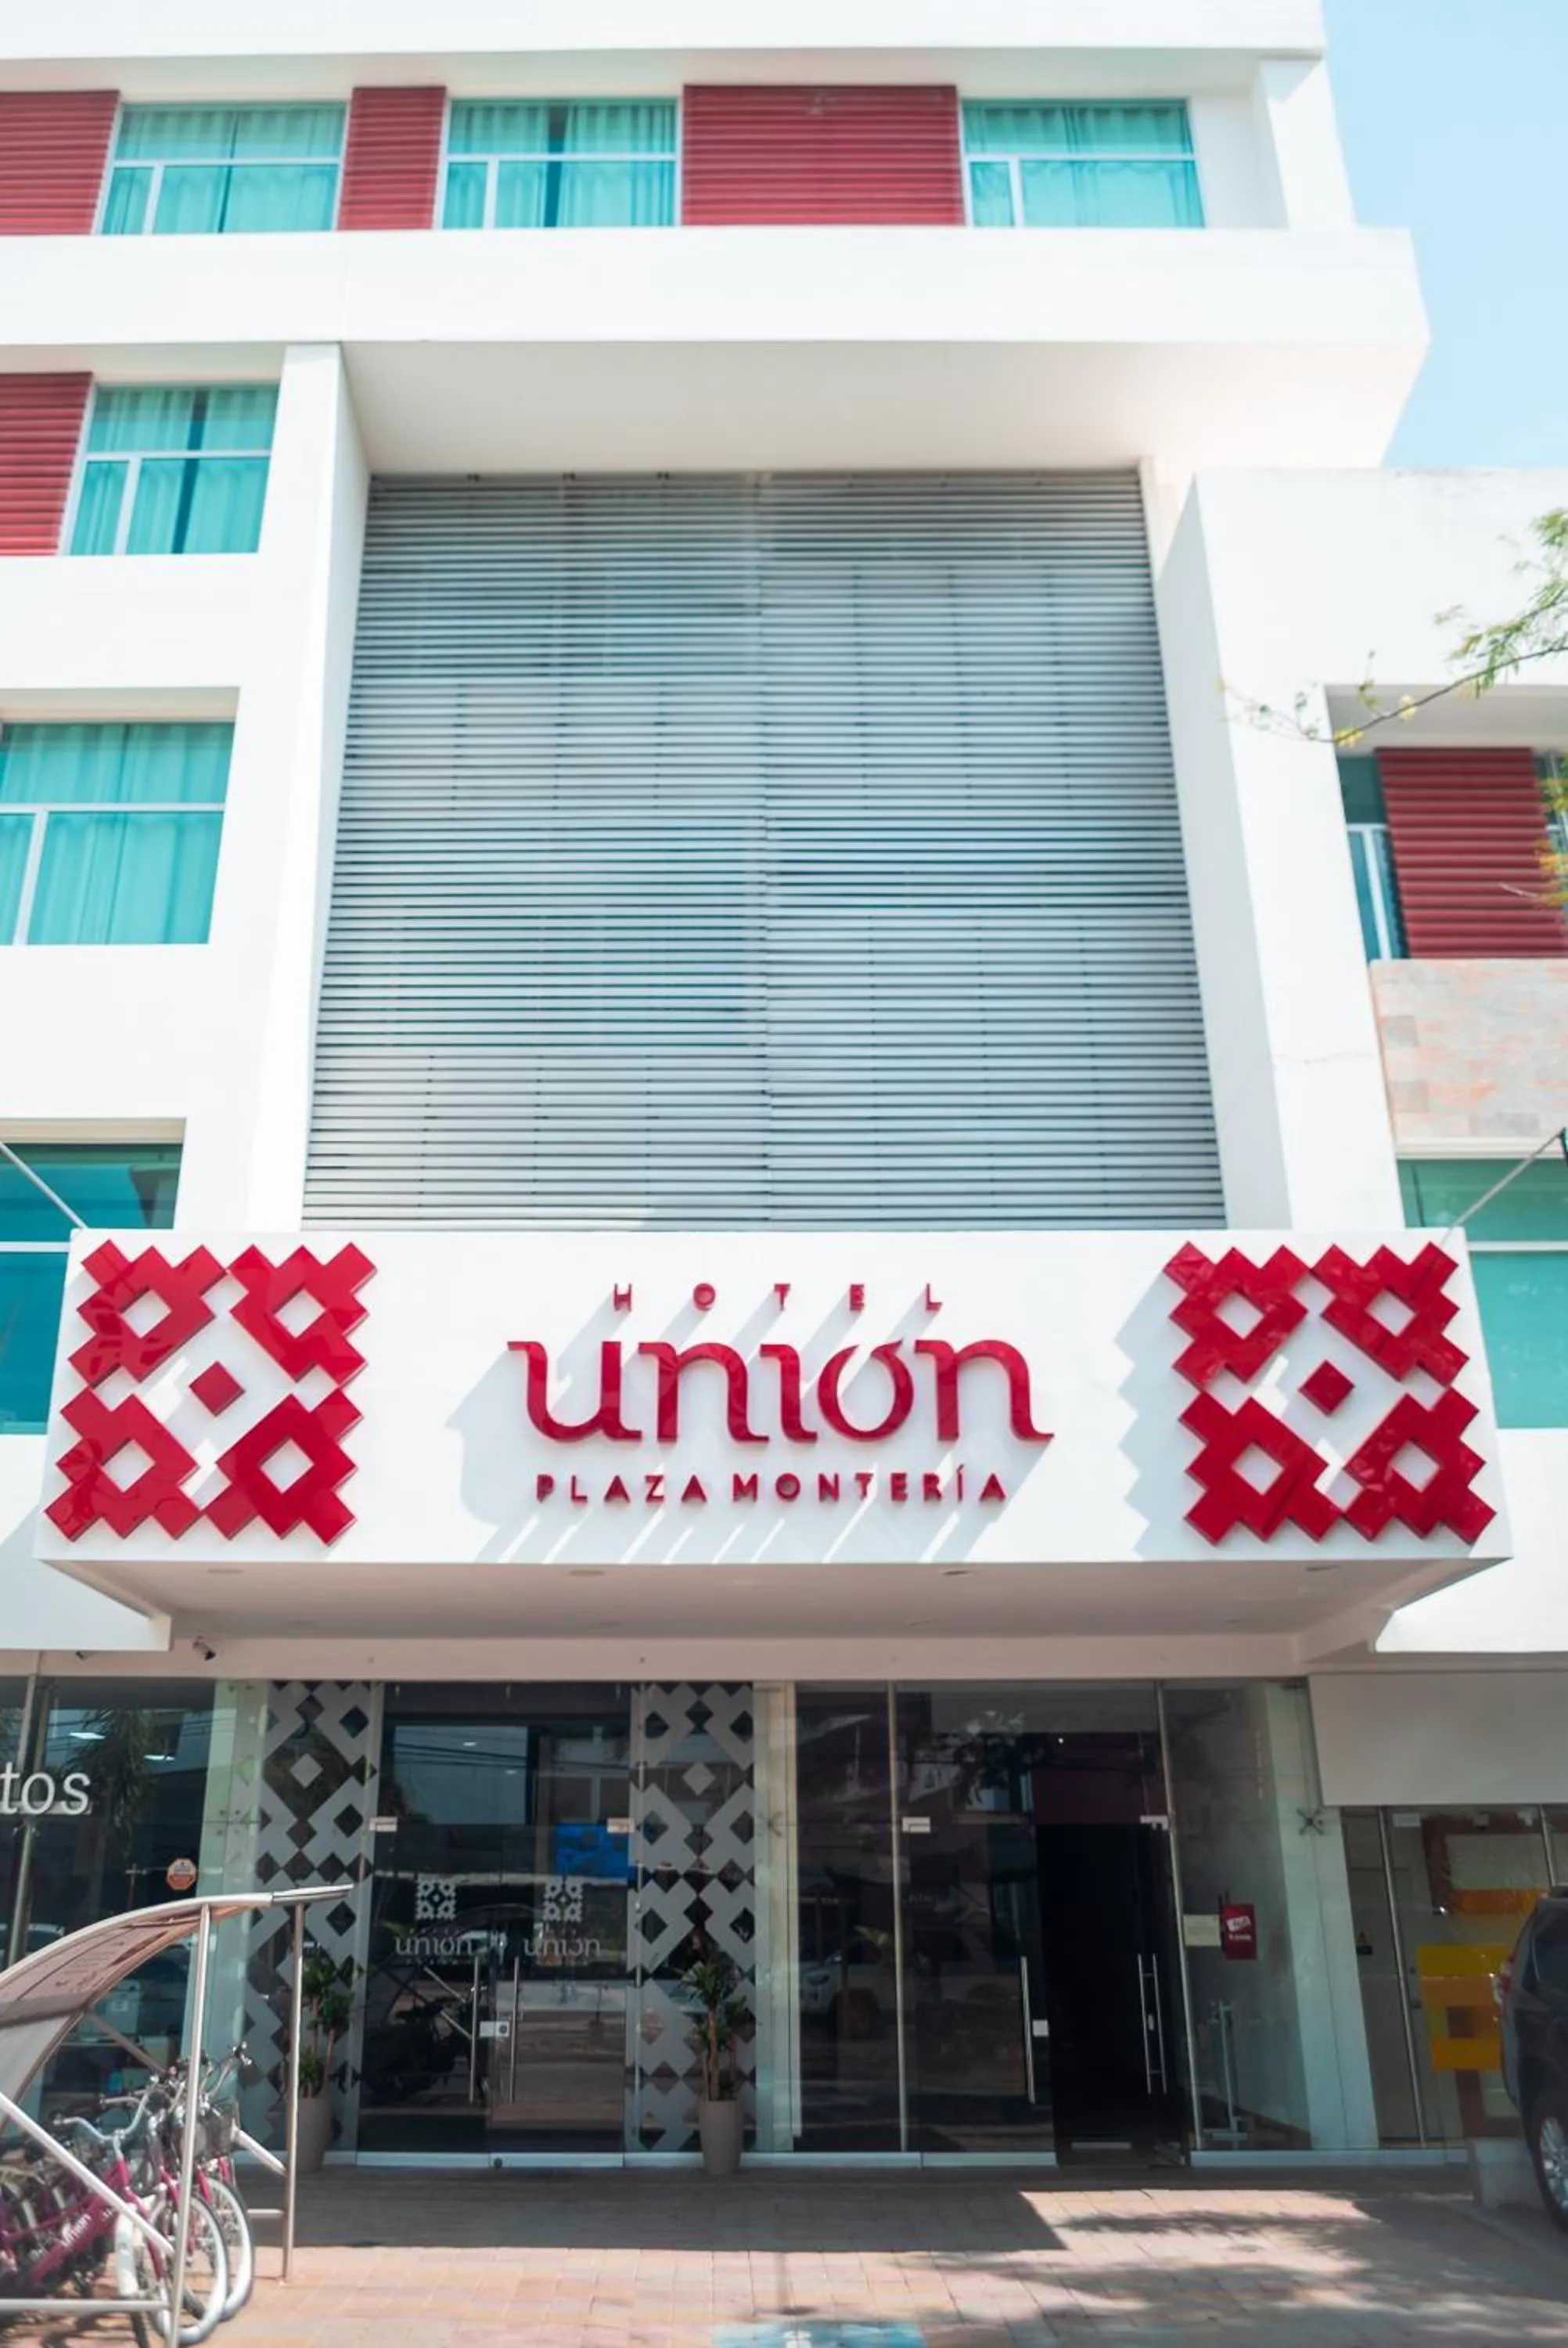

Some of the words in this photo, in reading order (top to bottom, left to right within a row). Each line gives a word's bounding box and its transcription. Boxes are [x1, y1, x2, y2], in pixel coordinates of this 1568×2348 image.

[613, 1283, 944, 1311] HOTEL
[536, 1474, 707, 1503] PLAZA
[732, 1464, 1007, 1503] MONTERÍA
